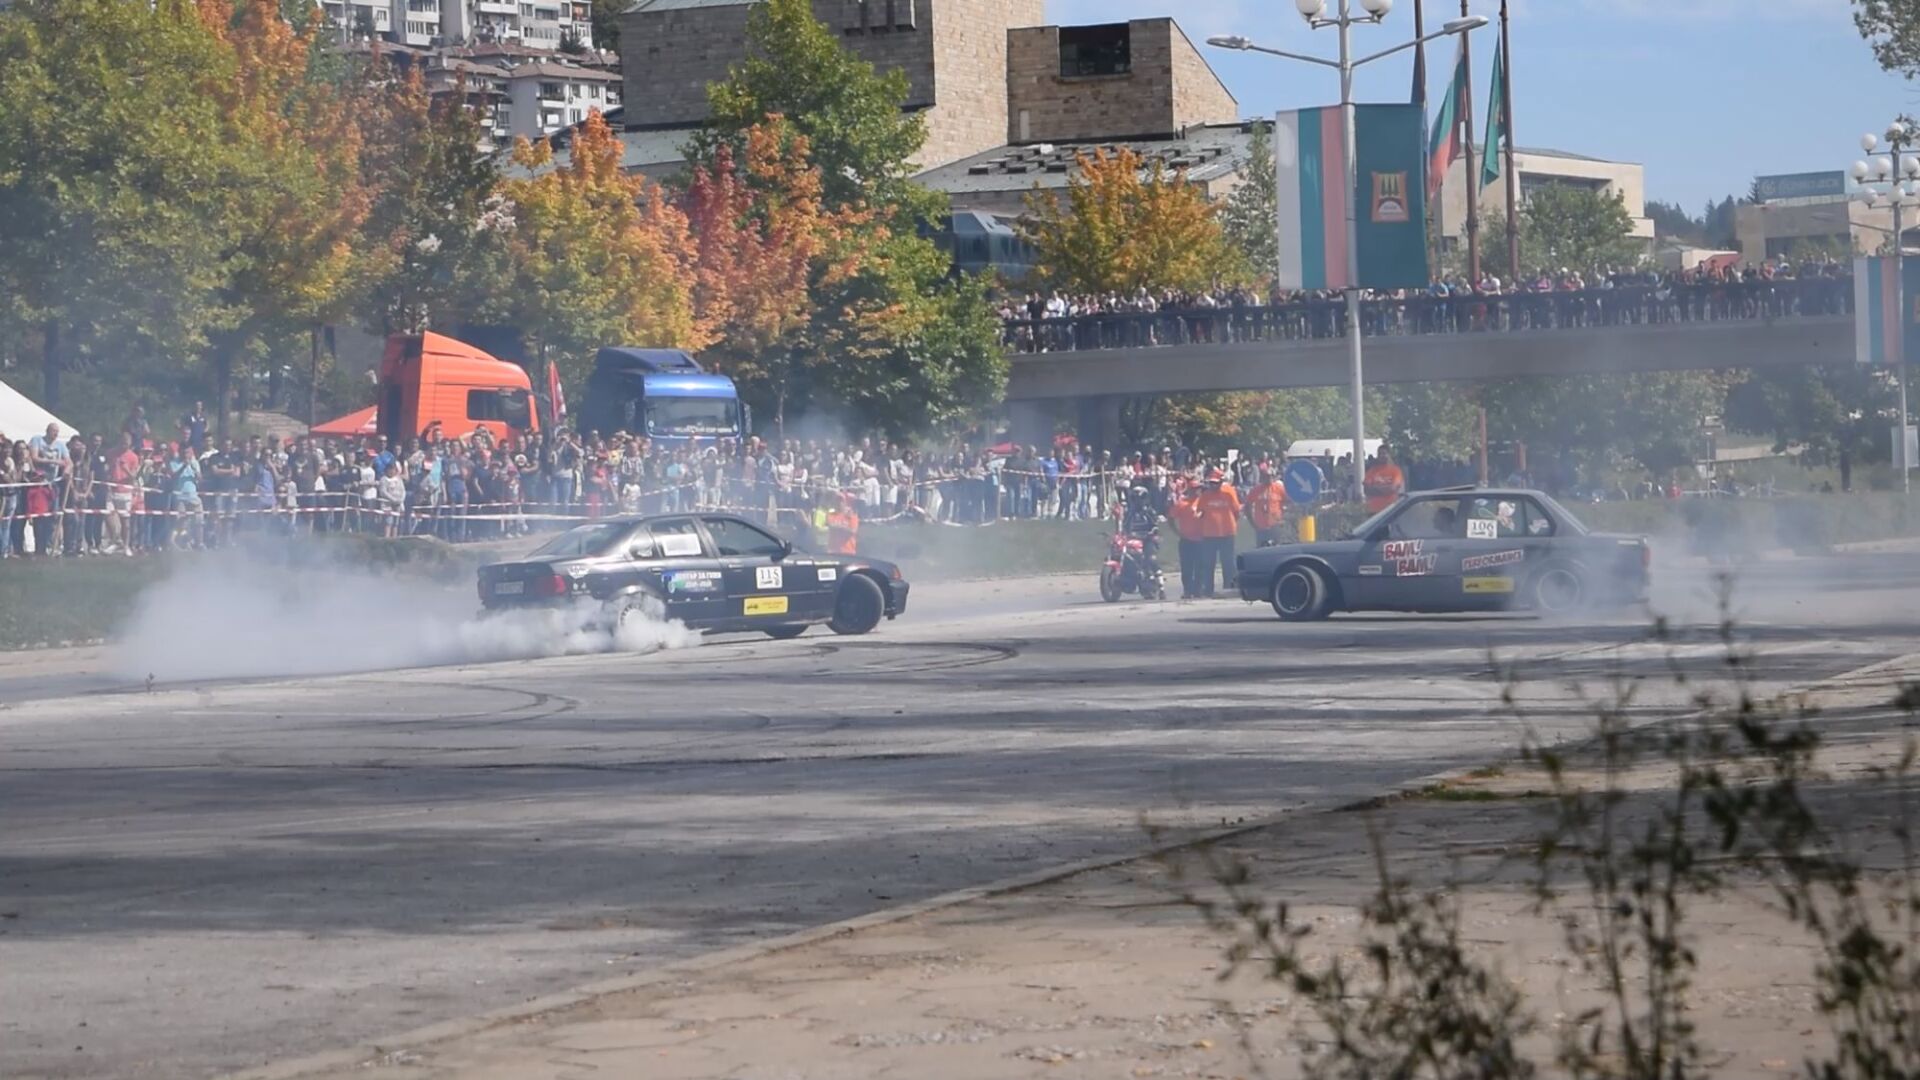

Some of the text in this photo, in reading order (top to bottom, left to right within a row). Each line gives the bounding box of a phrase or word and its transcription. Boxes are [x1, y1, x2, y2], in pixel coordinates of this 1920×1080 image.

[1471, 521, 1494, 531] 106
[1384, 540, 1423, 559] BAM!
[1397, 554, 1436, 574] BAM!
[1463, 550, 1521, 569] PERFORMANCE
[760, 568, 779, 580] 115
